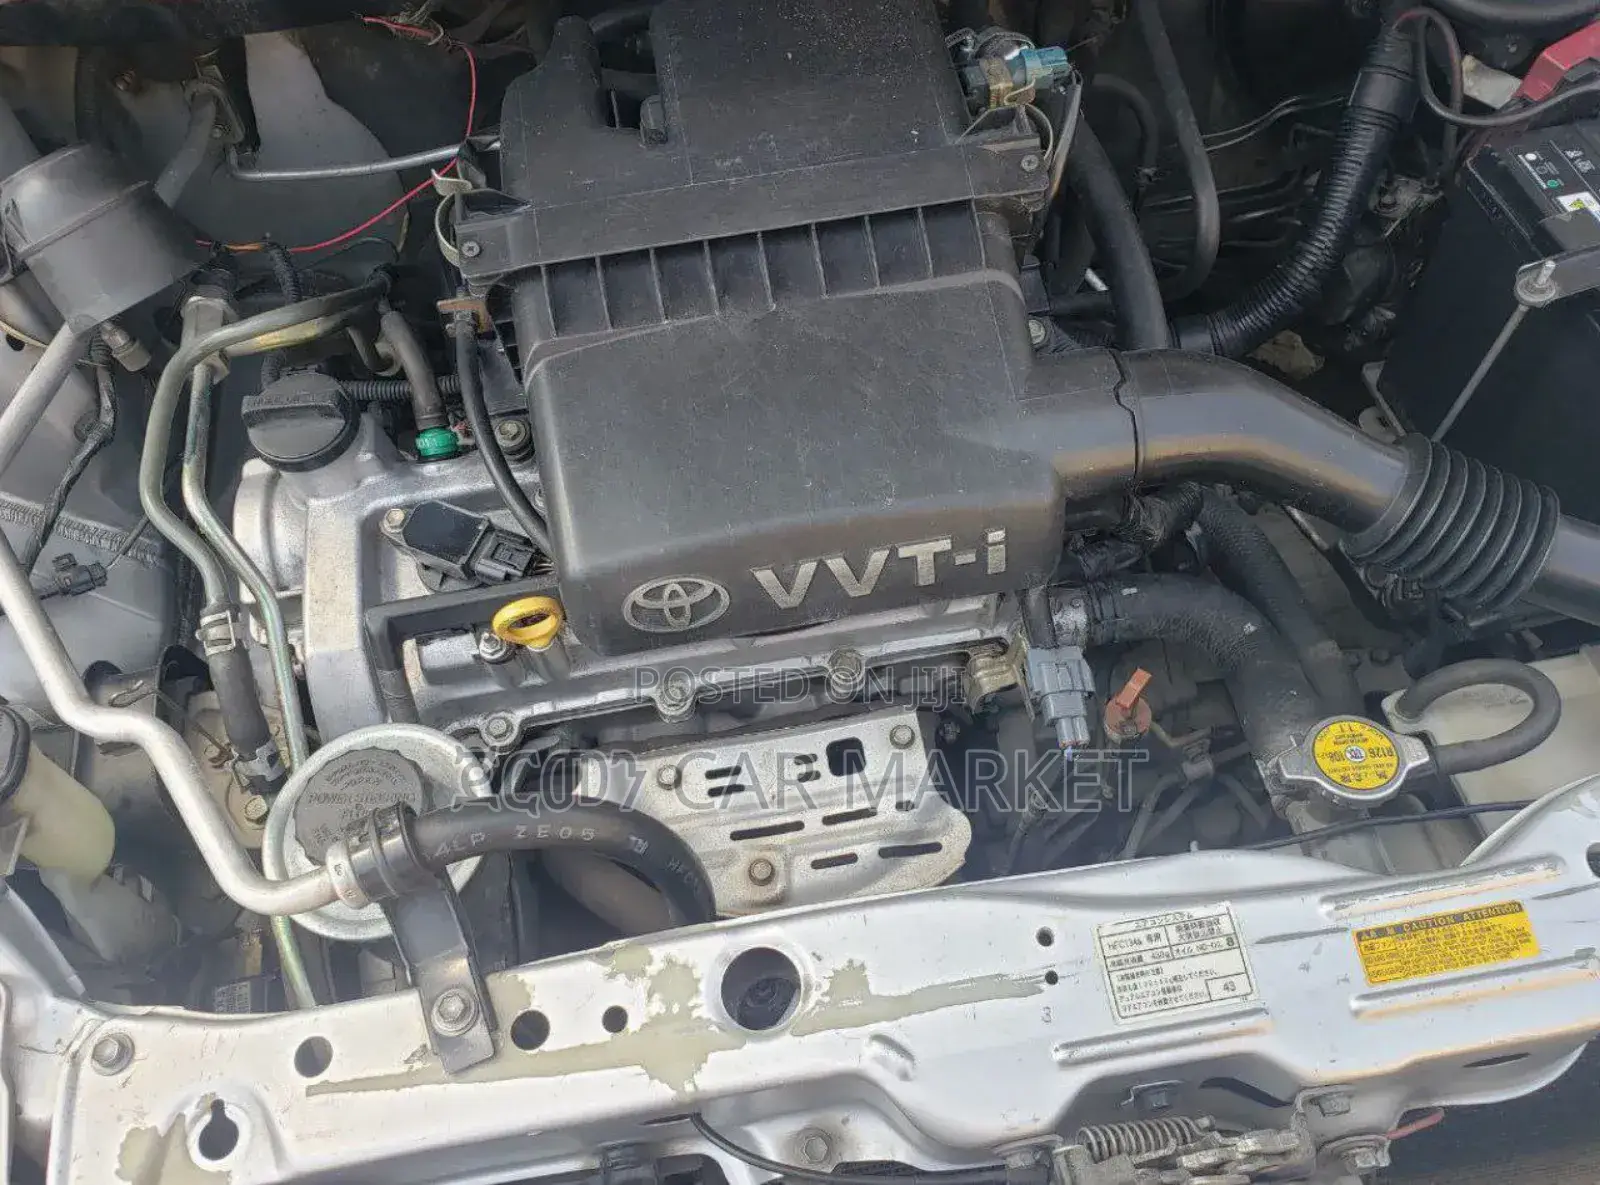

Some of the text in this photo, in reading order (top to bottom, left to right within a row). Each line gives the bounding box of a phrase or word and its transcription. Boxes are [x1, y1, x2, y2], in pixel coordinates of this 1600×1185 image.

[750, 528, 1007, 610] VVT-i
[1403, 915, 1456, 932] CAUTION
[1463, 901, 1522, 921] ATTENTION
